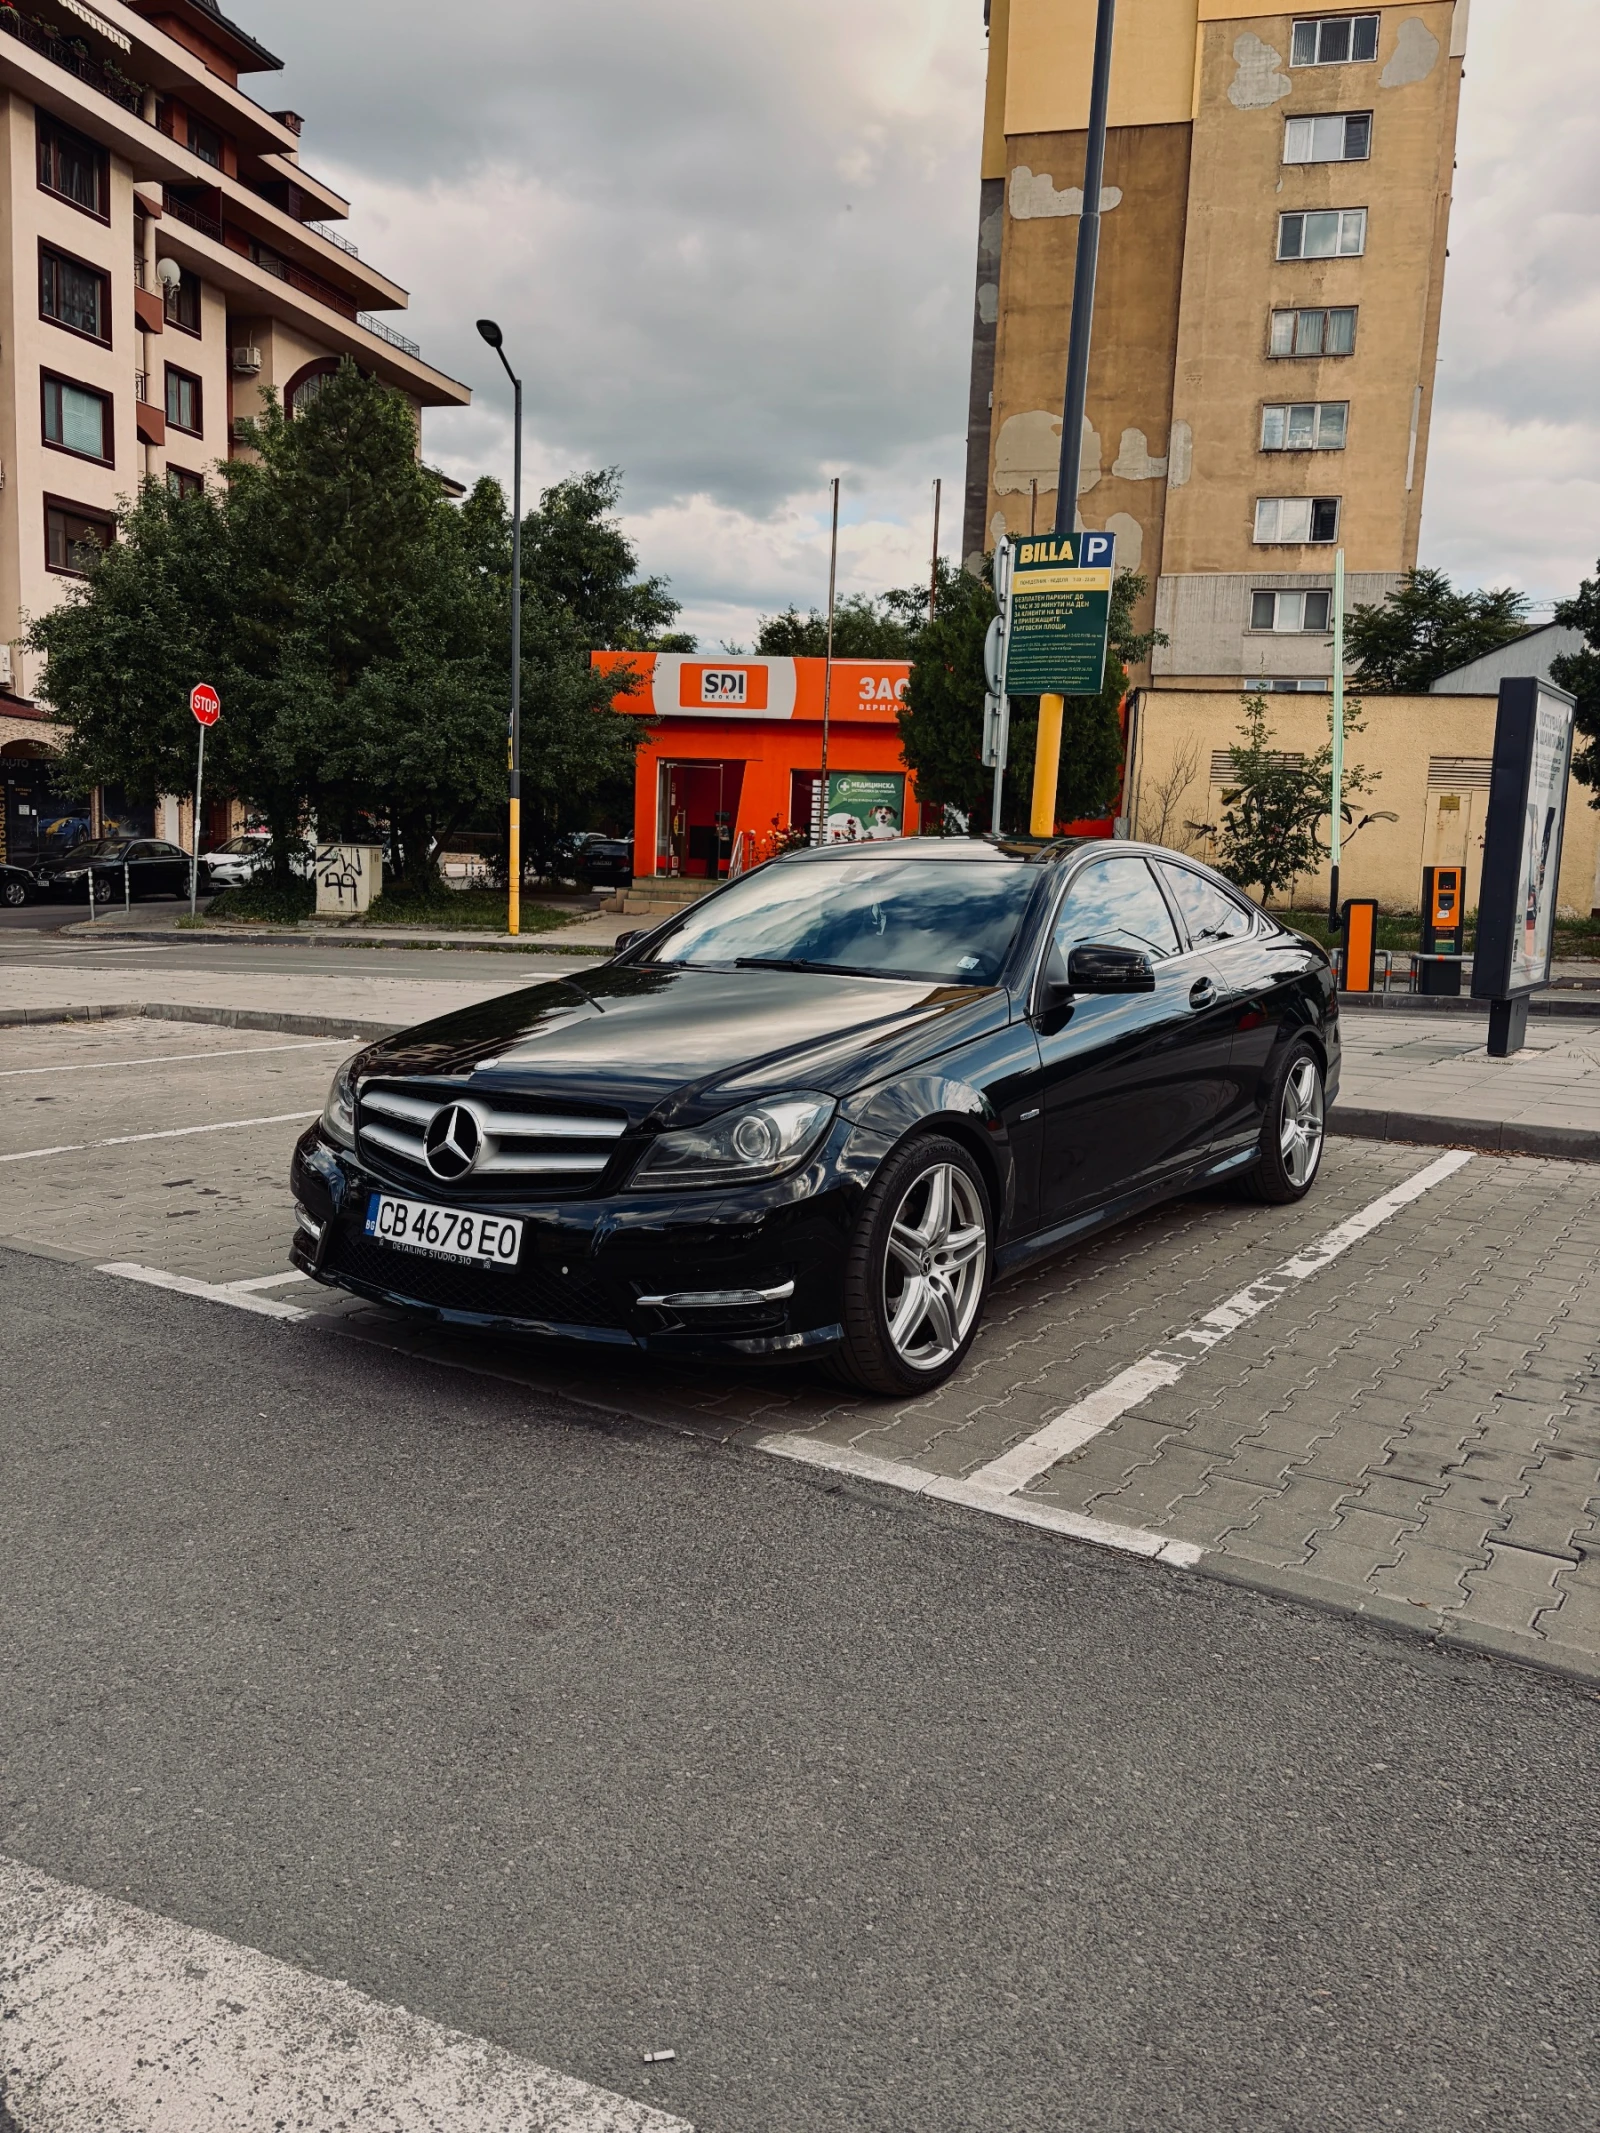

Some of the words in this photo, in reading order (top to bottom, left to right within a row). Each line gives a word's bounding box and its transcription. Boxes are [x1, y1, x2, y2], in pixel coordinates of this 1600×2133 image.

[1019, 540, 1074, 564] BILLA
[1087, 537, 1109, 563] P
[1045, 593, 1074, 601] ПАРКИНГ
[1074, 593, 1084, 601] ДО
[1043, 623, 1067, 631] ПЛОЩИ
[704, 673, 744, 694] SDI
[194, 694, 218, 714] STOP
[851, 781, 895, 789] МЕДИЦИНСКА
[365, 1219, 376, 1231] BG
[379, 1201, 409, 1238] CB
[411, 1208, 475, 1251] 4678
[477, 1219, 517, 1259] EO
[392, 1241, 427, 1257] DETAILING
[428, 1250, 457, 1262] STUDIO
[457, 1255, 472, 1265] 310
